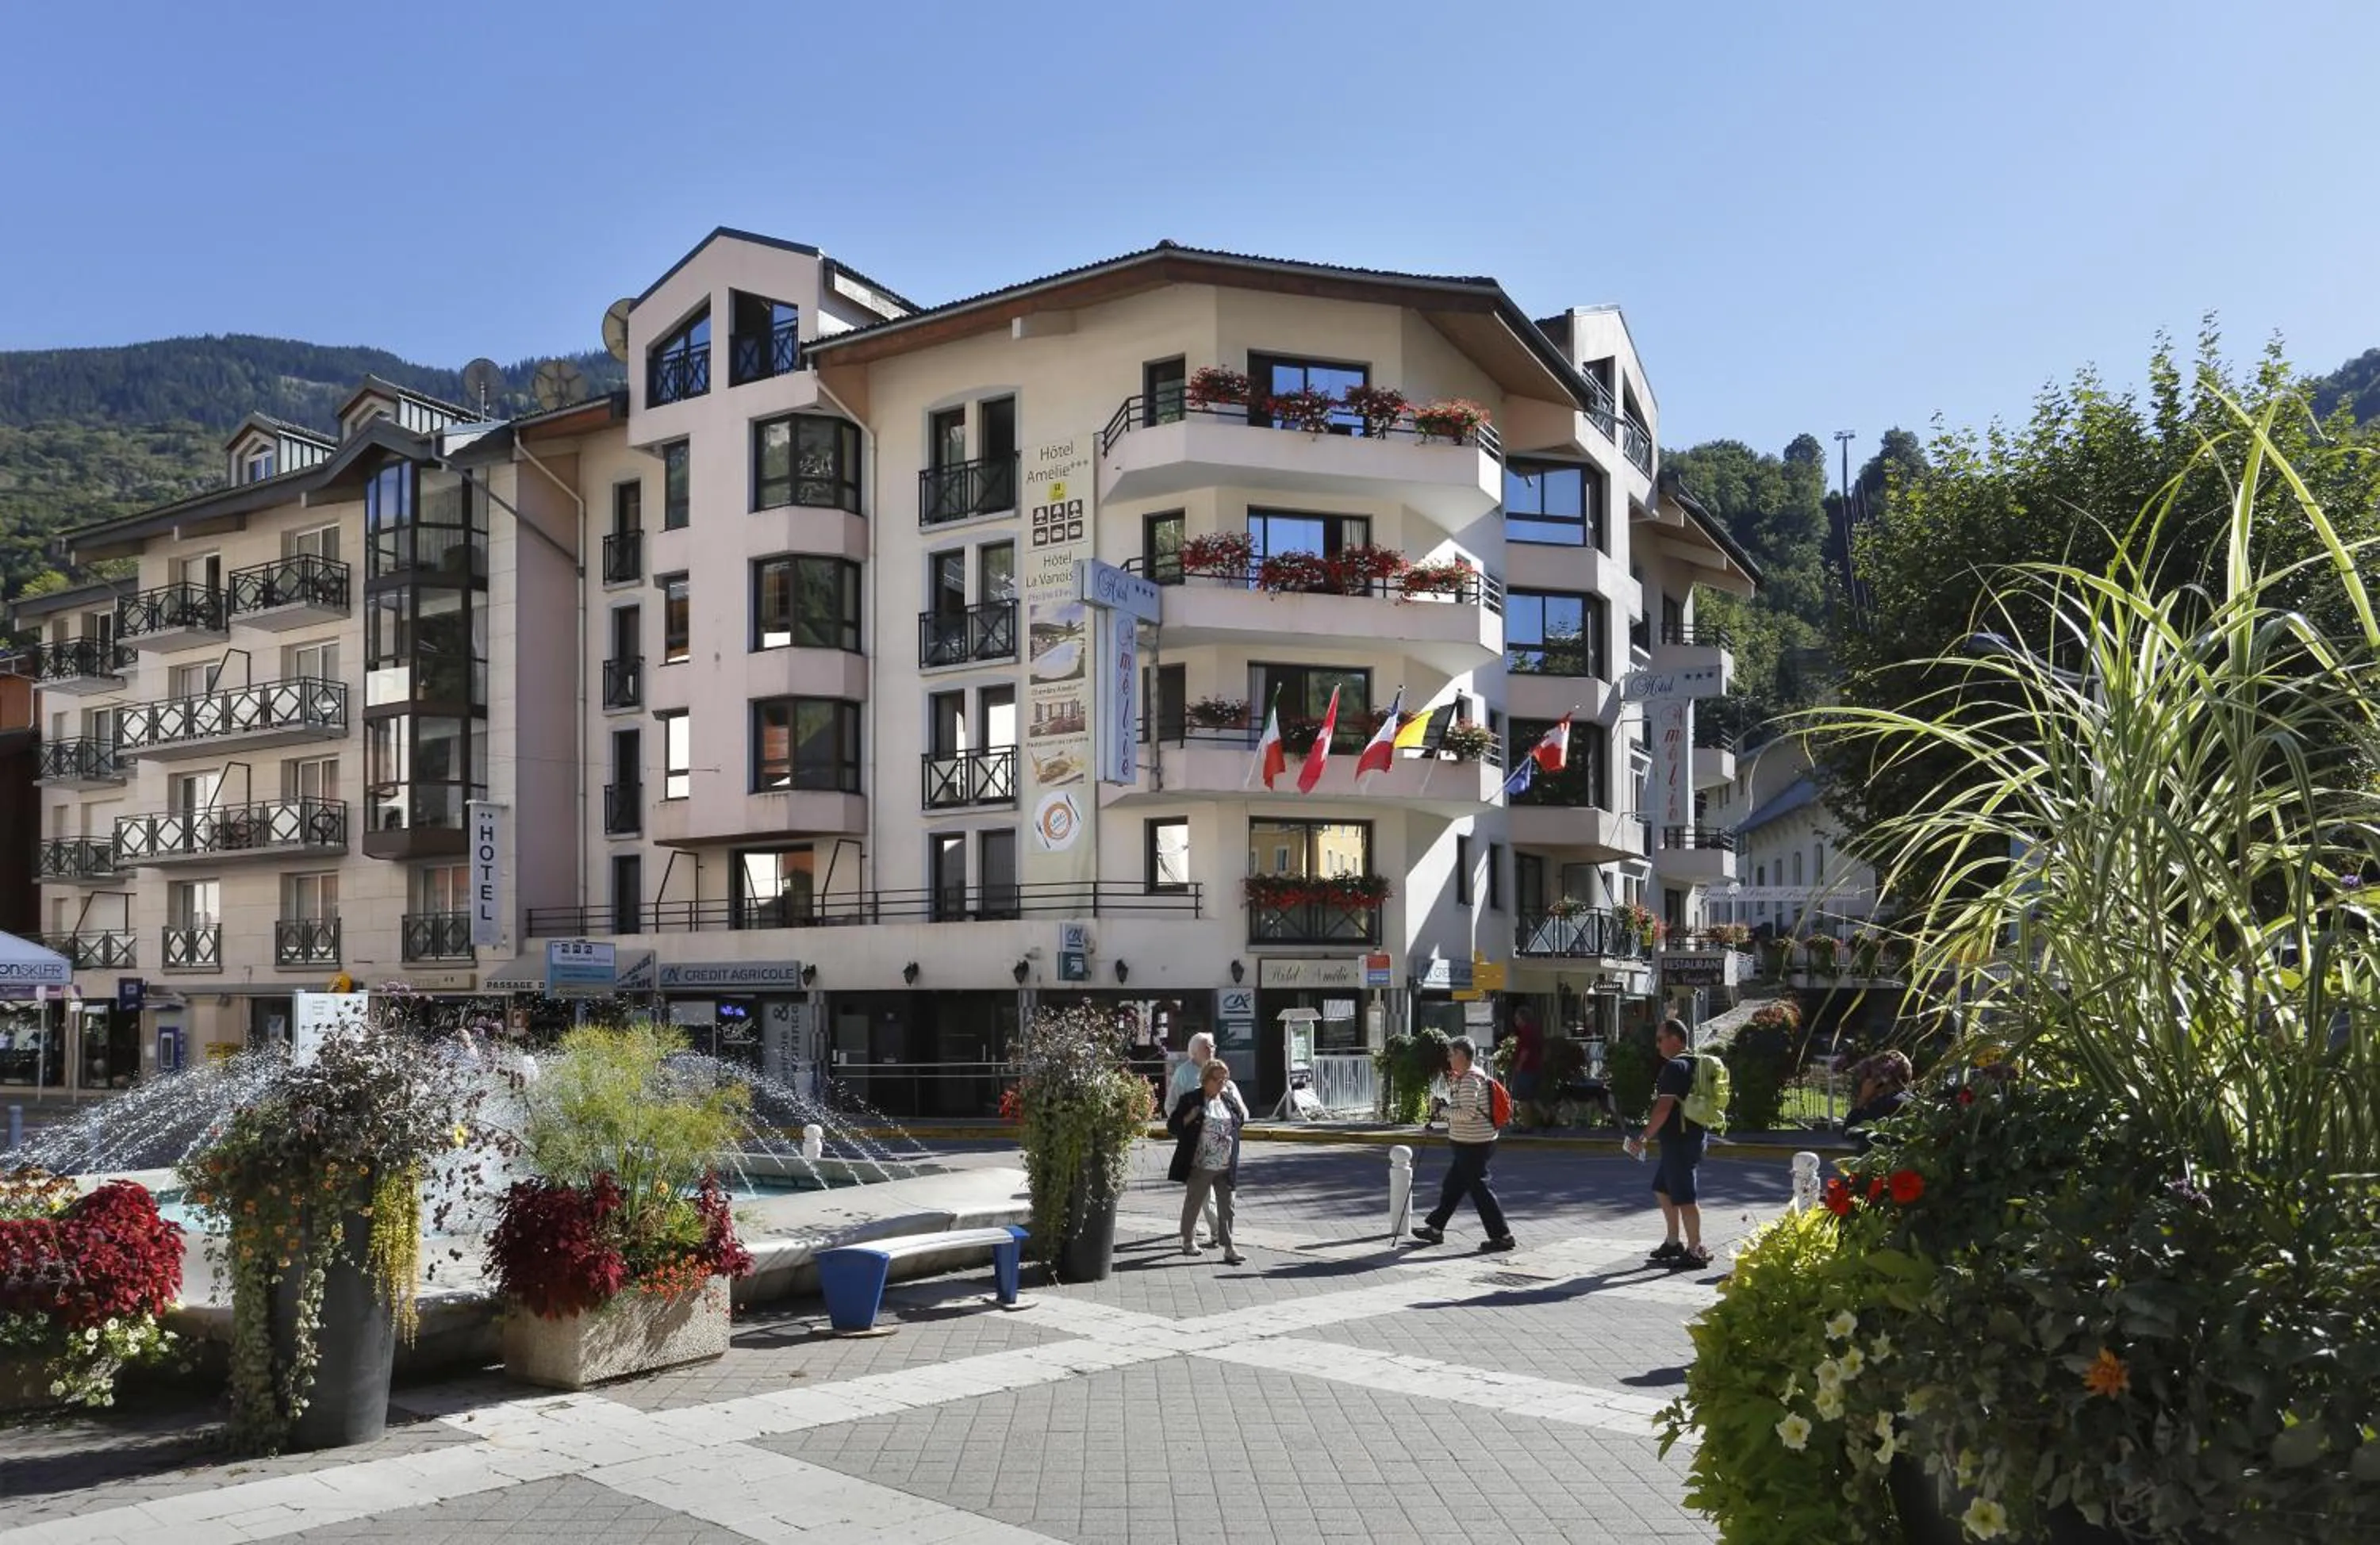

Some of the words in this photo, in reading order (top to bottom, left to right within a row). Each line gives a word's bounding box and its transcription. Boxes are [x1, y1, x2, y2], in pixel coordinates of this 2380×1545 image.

[1040, 441, 1073, 462] Hôtel
[1038, 569, 1073, 585] Vanois
[479, 825, 494, 921] HOTEL
[731, 968, 794, 981] AGRICOLE
[1223, 993, 1251, 1009] CA
